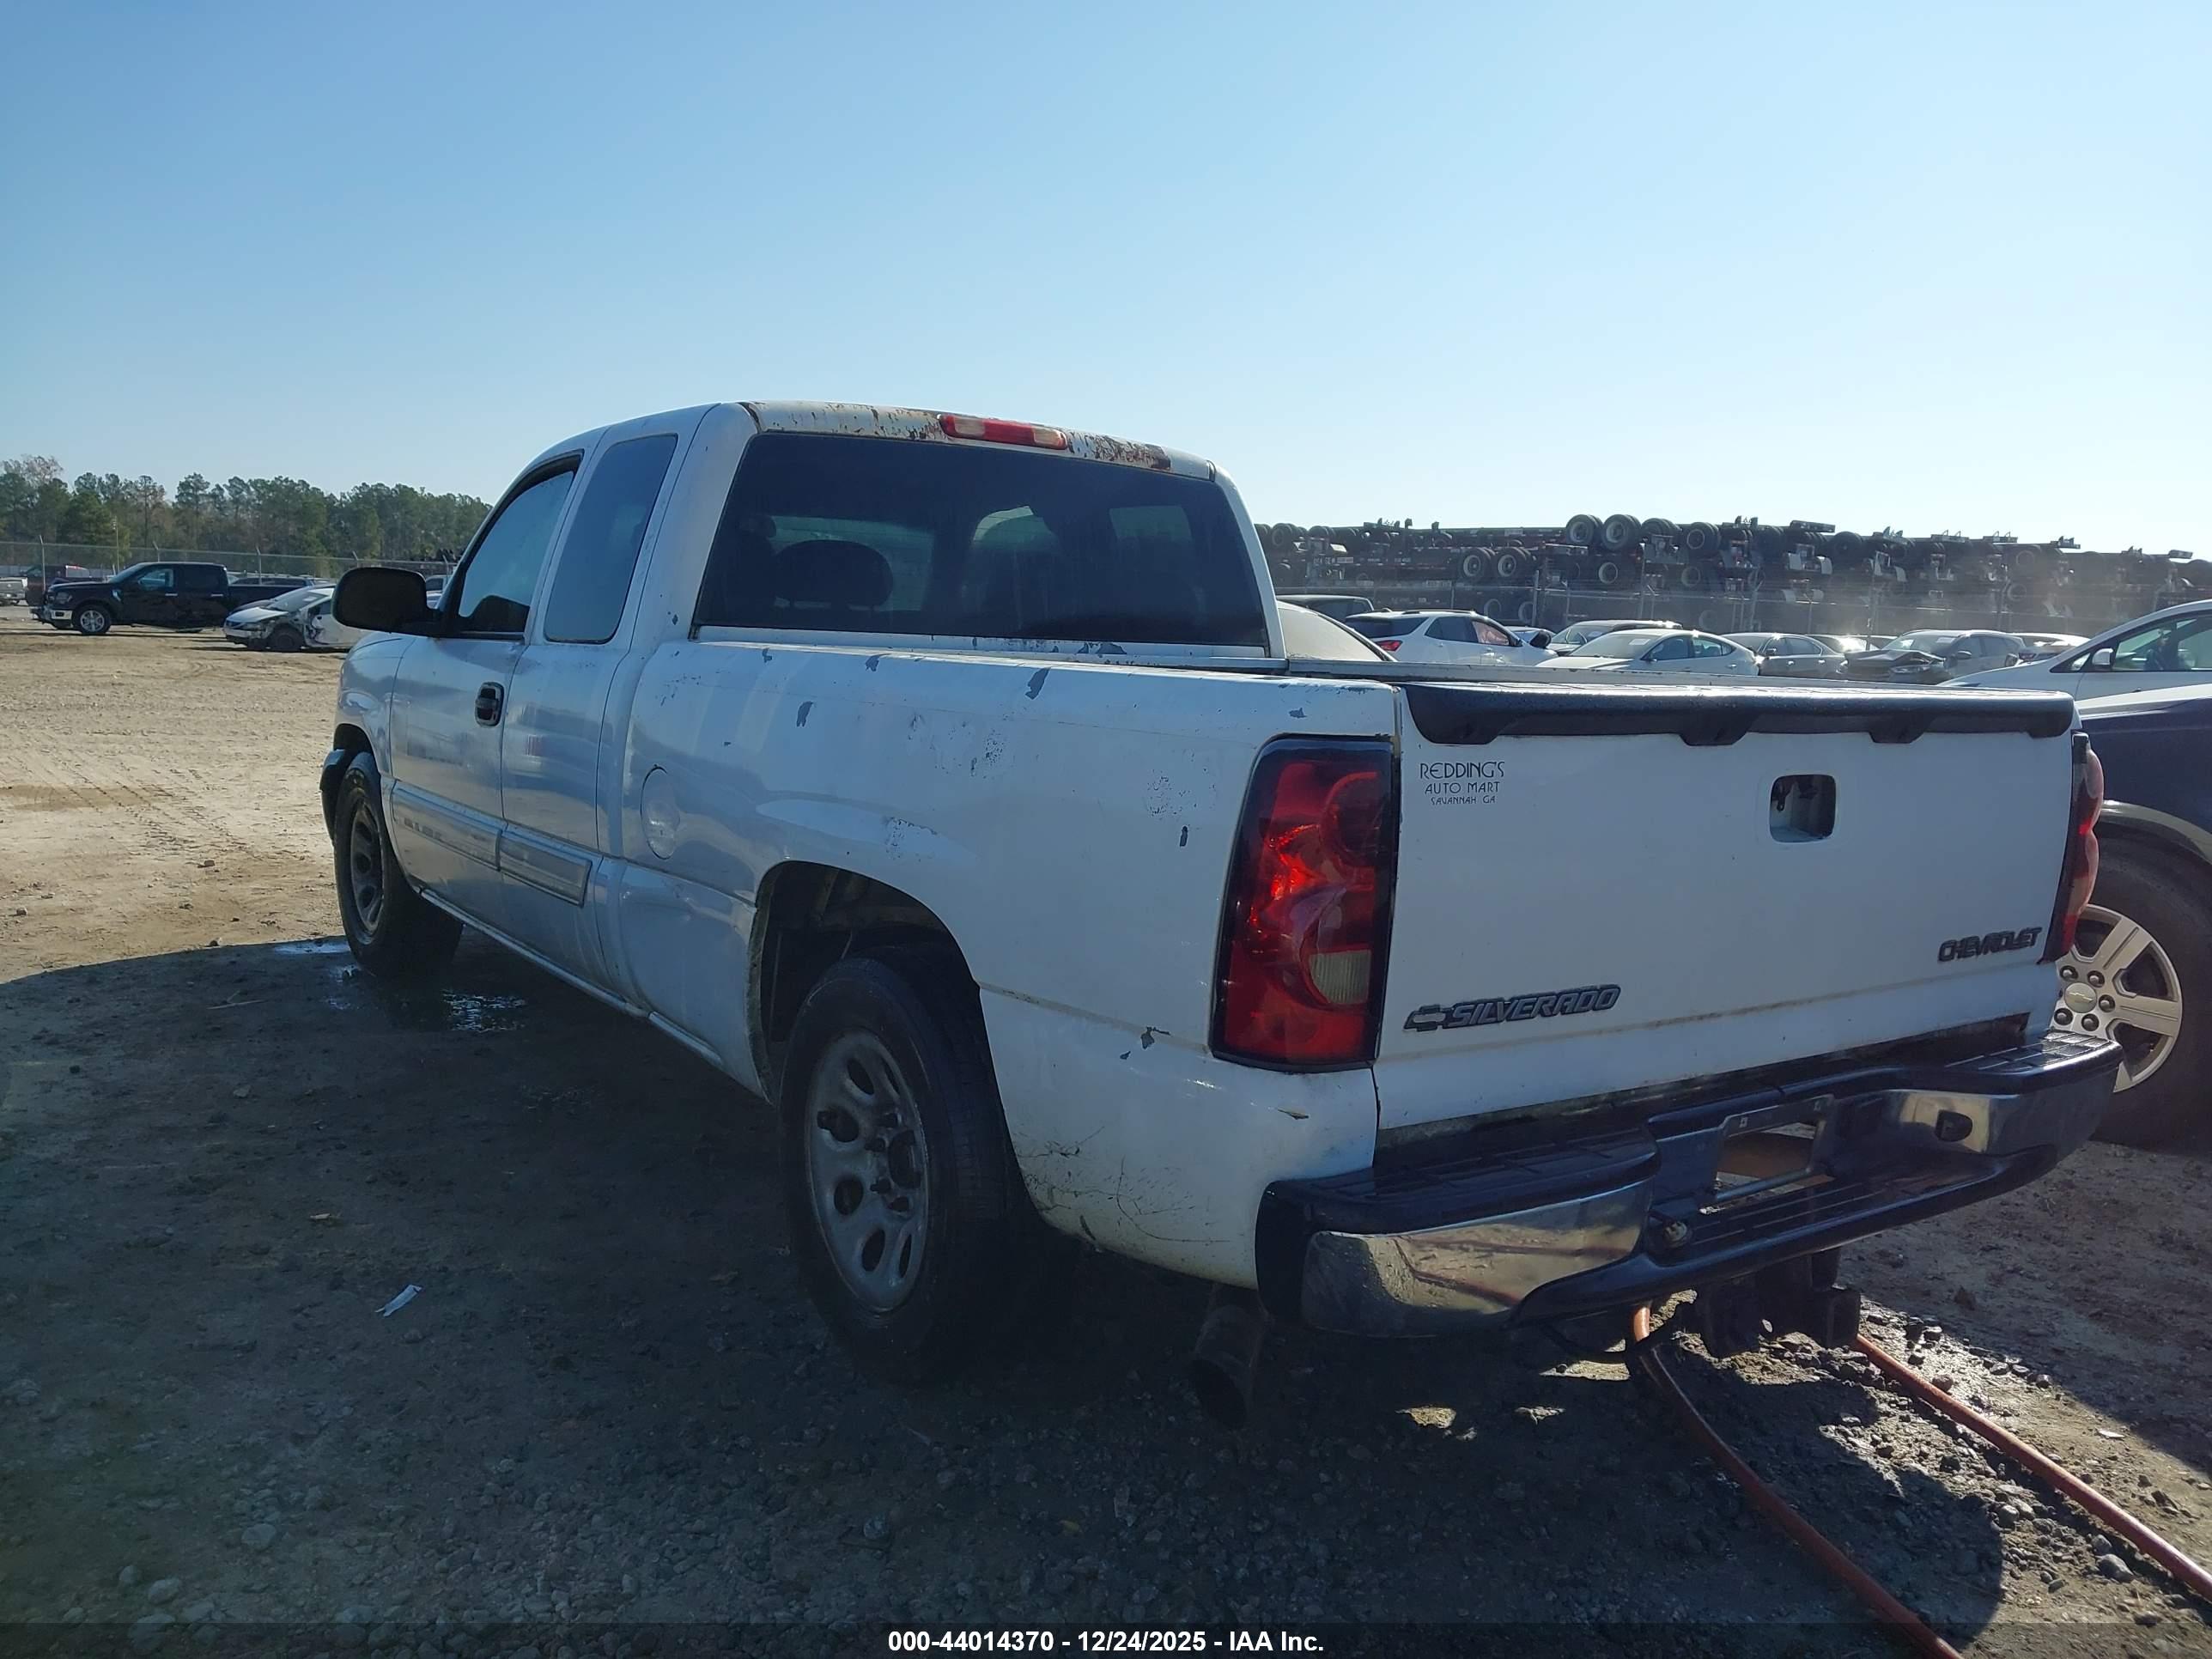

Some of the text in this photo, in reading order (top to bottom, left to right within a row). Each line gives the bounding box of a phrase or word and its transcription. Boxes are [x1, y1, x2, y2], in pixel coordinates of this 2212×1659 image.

[1425, 781, 1501, 794] AUTO MART
[1431, 794, 1496, 805] SAVANNAH GA
[1937, 927, 2043, 963] CHEVROLET
[1443, 984, 1621, 1030] SILVERADO
